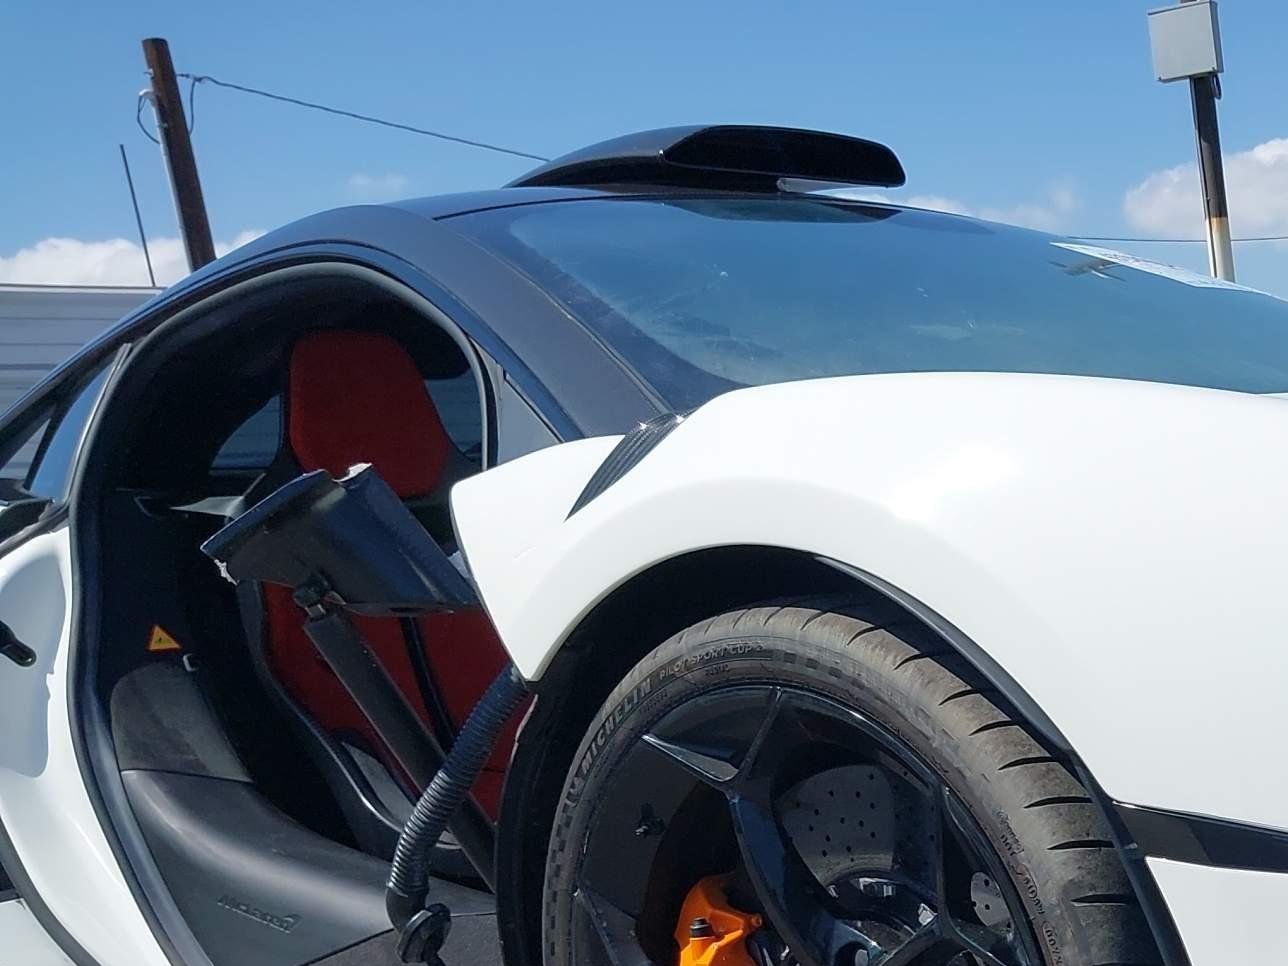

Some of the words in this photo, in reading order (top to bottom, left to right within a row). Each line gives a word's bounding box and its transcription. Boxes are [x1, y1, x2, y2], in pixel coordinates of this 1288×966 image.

[659, 656, 692, 681] PILOT
[690, 646, 727, 666] SPORT
[729, 642, 754, 655] CUP
[579, 676, 653, 776] MICHELIN
